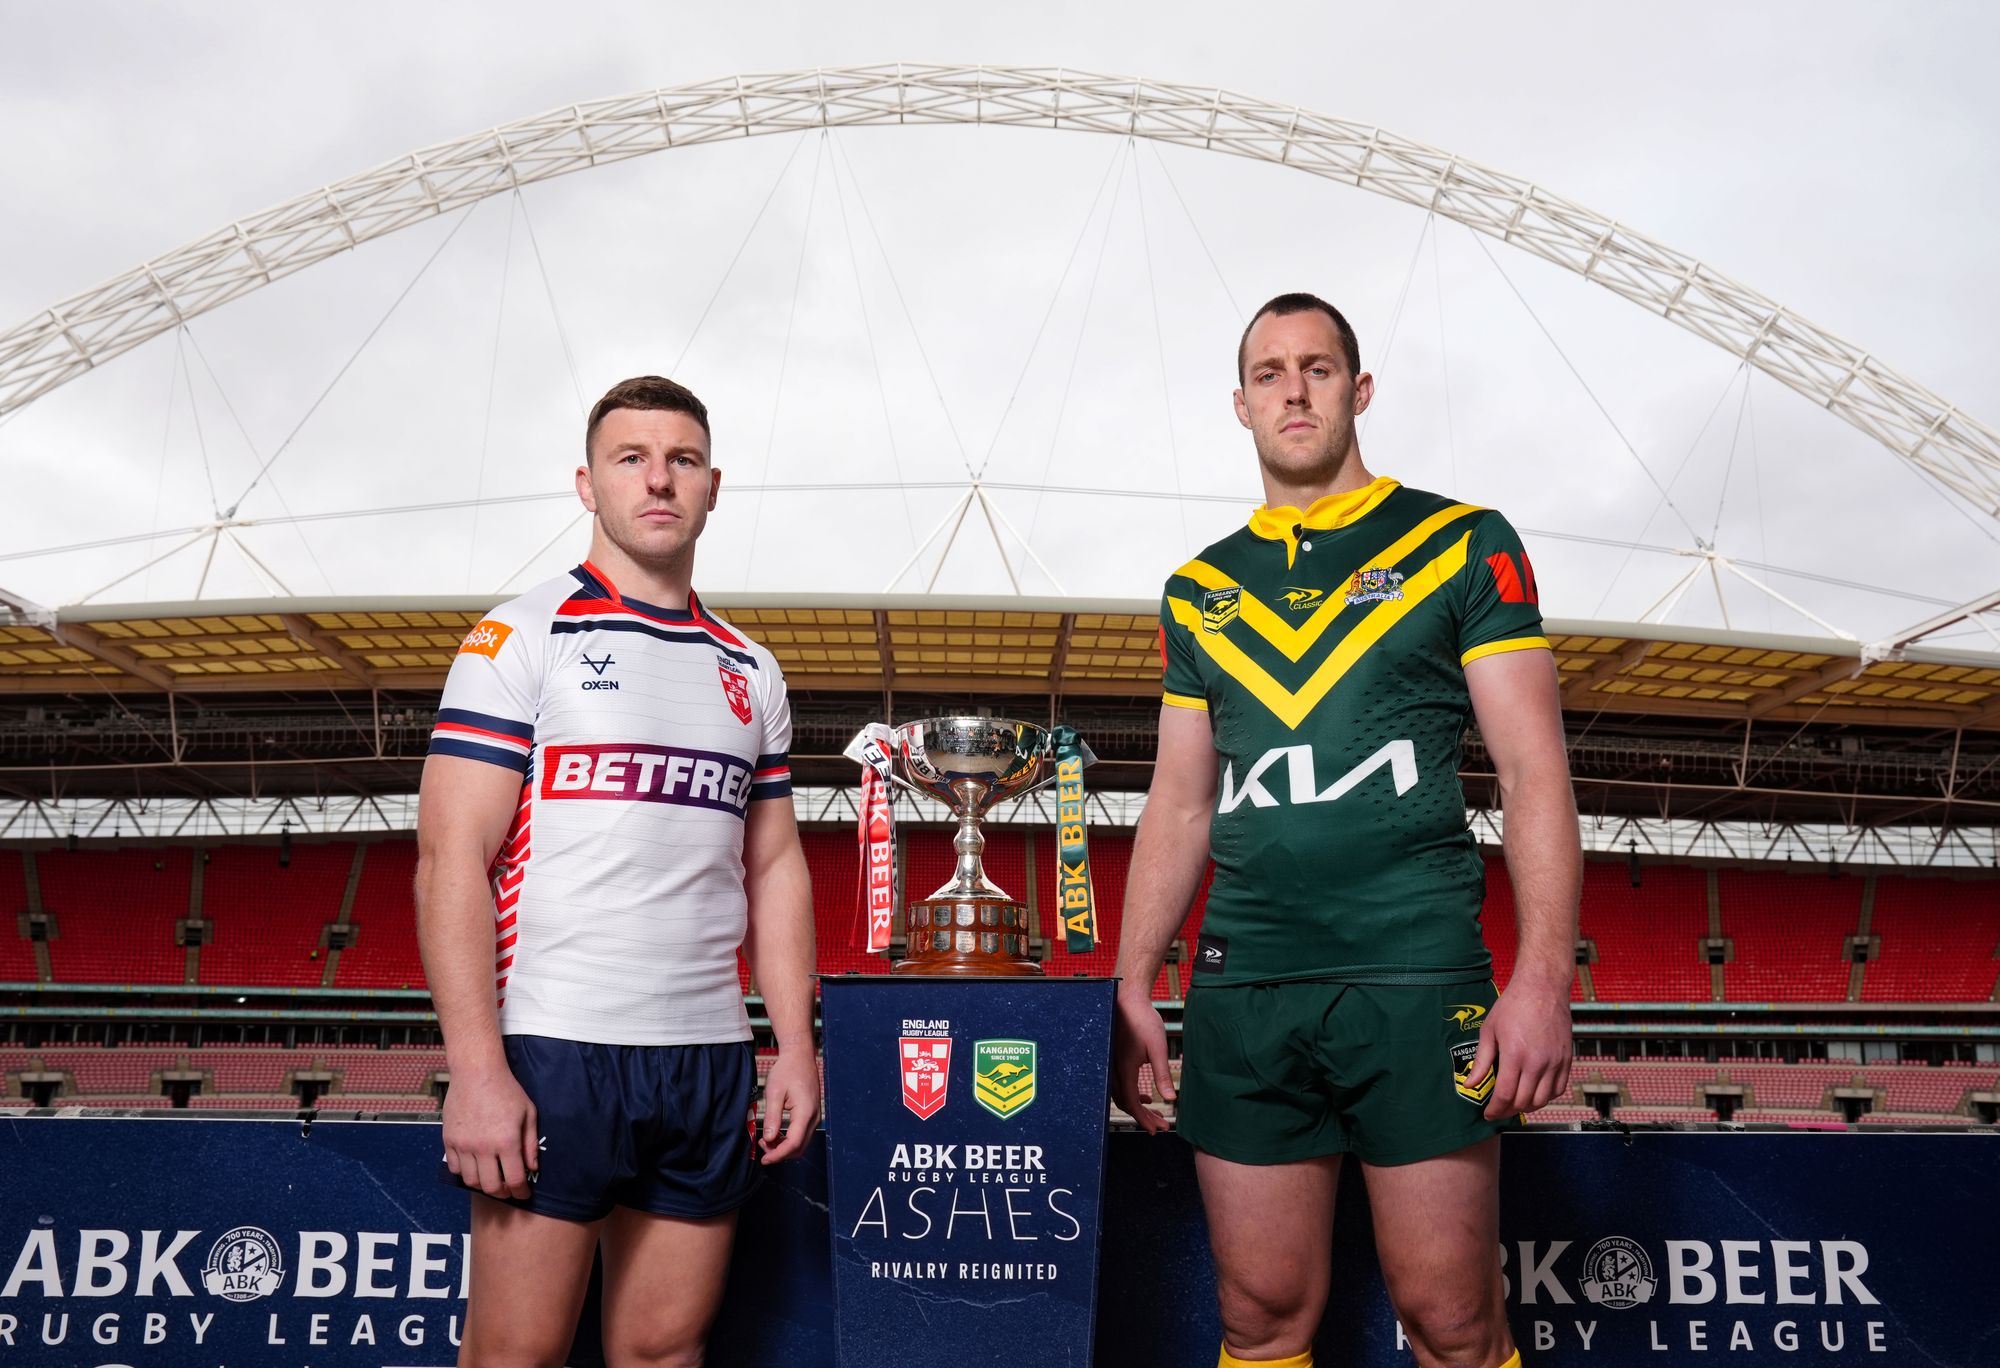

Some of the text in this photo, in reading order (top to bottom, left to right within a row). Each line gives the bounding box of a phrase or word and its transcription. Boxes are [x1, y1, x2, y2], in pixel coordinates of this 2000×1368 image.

[1293, 600, 1323, 610] CLASSIC
[581, 680, 619, 690] OXEN
[1058, 758, 1090, 935] ABK BEER
[869, 781, 890, 932] BK BEER
[902, 1019, 949, 1030] ENGLAND
[980, 1046, 1031, 1055] KANGAROOS
[889, 1143, 1045, 1170] ABK BEER
[888, 1171, 1047, 1184] RUGBY LEAGUE
[852, 1186, 1081, 1241] ASHES
[226, 1231, 240, 1242] 700
[242, 1230, 264, 1241] YEARS
[1597, 1240, 1611, 1252] 700
[1612, 1240, 1633, 1250] YEARS
[1, 1229, 471, 1299] ABK BEE
[871, 1262, 1058, 1280] RIVALRY REIGNITED
[1665, 1239, 1881, 1305] BEER
[223, 1274, 263, 1292] ABK
[1601, 1282, 1638, 1299] ABK
[0, 1313, 461, 1347] RUGBY LEAG
[1650, 1320, 1887, 1352] LEAGUE
